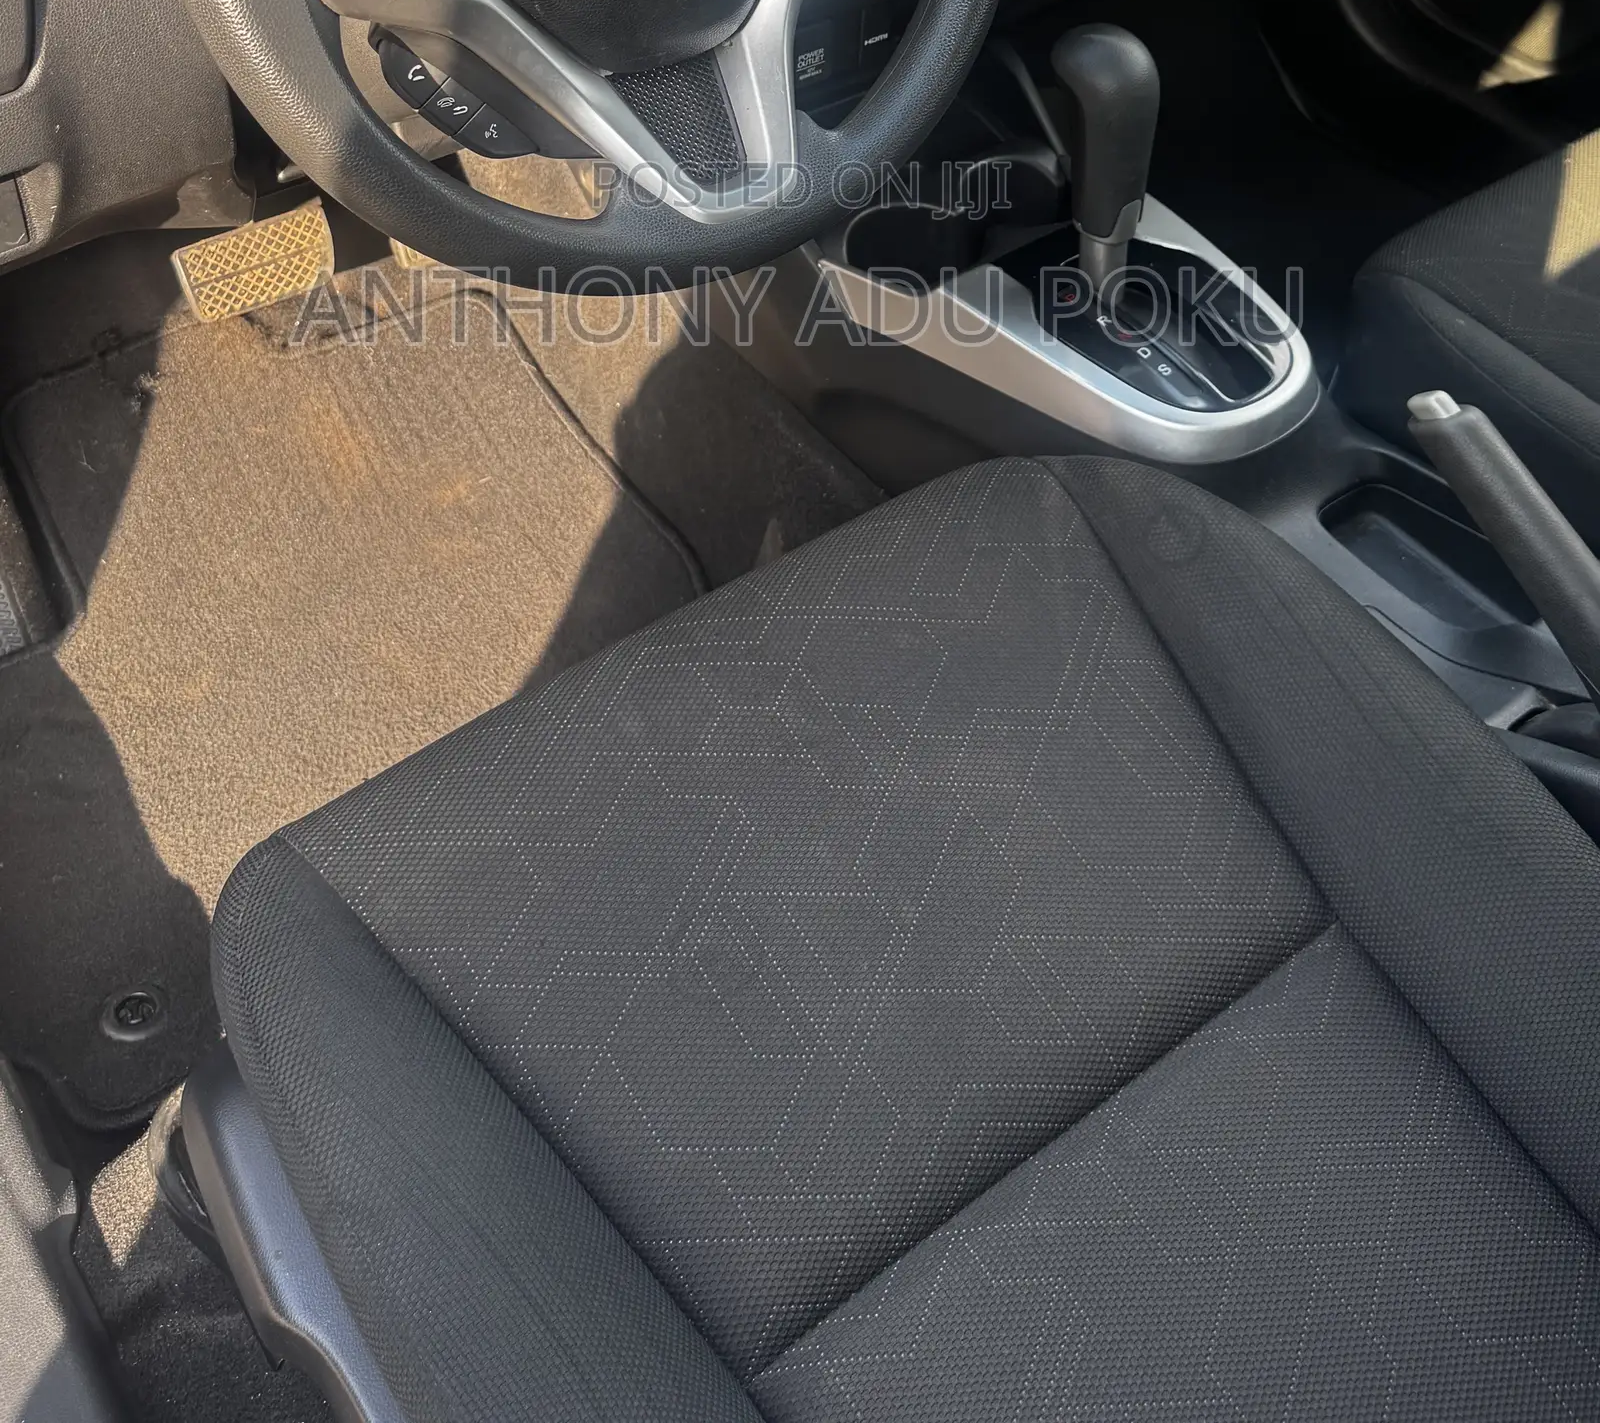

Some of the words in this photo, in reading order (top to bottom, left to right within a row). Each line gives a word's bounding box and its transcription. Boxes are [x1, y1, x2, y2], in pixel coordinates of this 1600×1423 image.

[864, 33, 889, 46] HDMI
[798, 48, 824, 61] POWER
[797, 54, 824, 69] OUTLET
[1096, 315, 1112, 328] R
[1136, 346, 1152, 359] D
[1157, 363, 1172, 376] S
